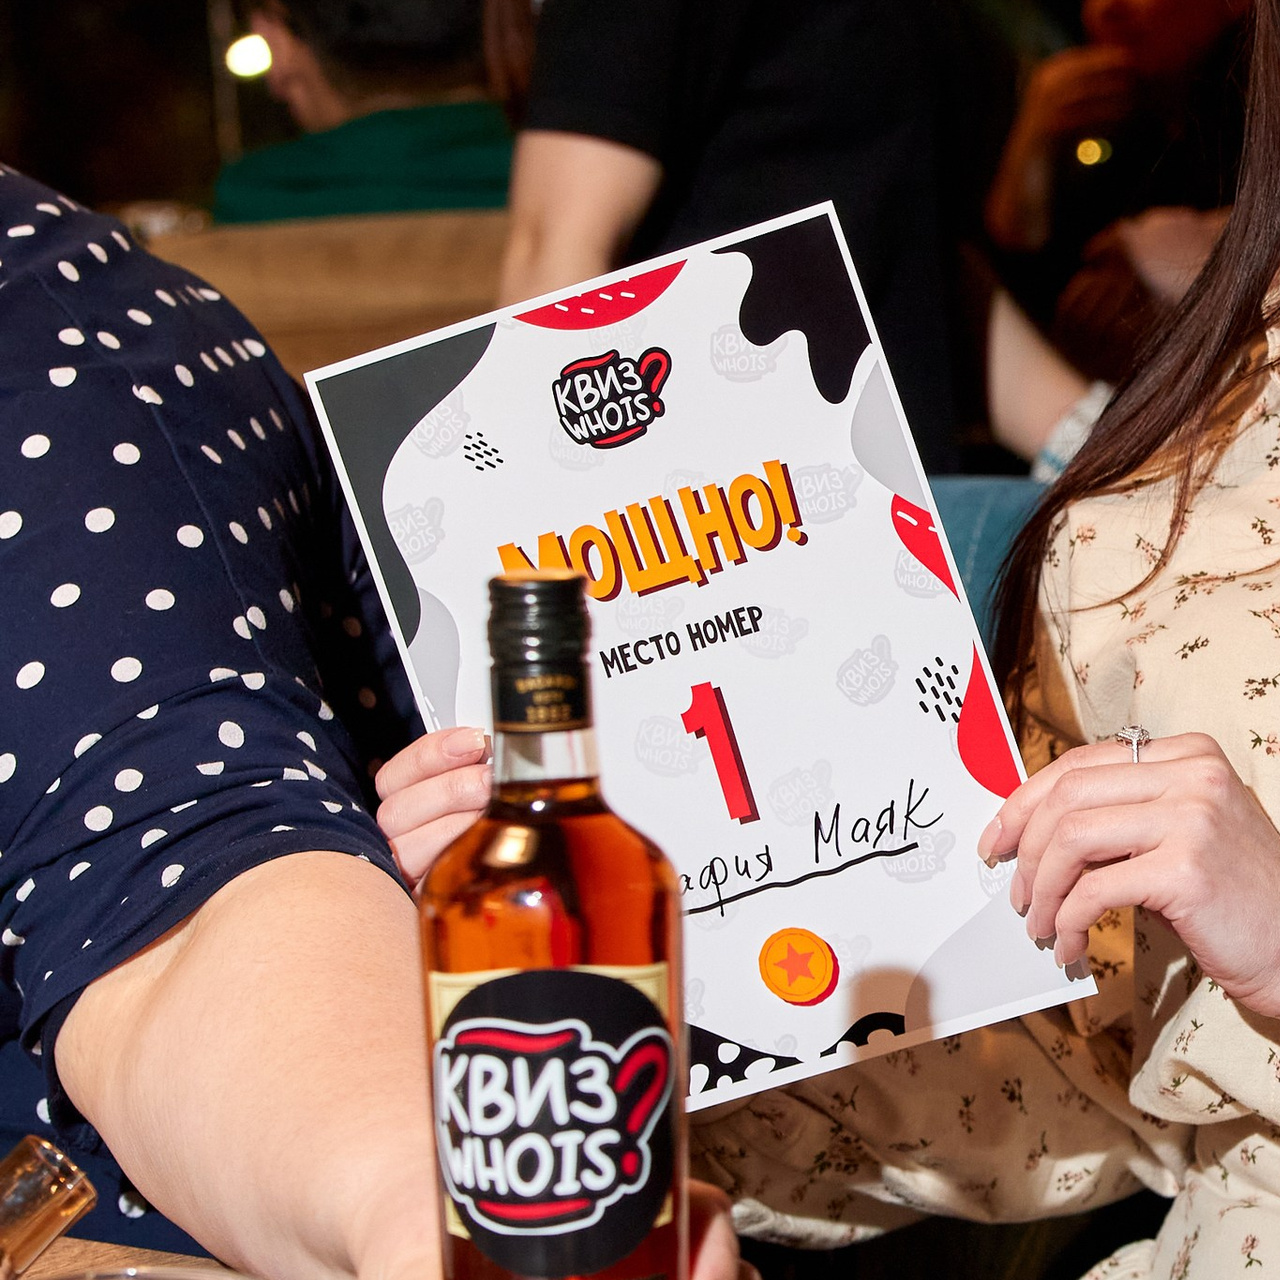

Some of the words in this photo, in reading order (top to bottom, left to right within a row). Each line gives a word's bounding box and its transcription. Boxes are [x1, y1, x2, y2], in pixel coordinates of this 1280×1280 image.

[555, 361, 643, 416] КВИЗ
[497, 459, 808, 602] МОЩНО!
[599, 631, 682, 678] МЕСТО
[686, 606, 763, 652] НОМЕР
[681, 681, 760, 825] 1
[442, 1053, 618, 1136] КВИЗ
